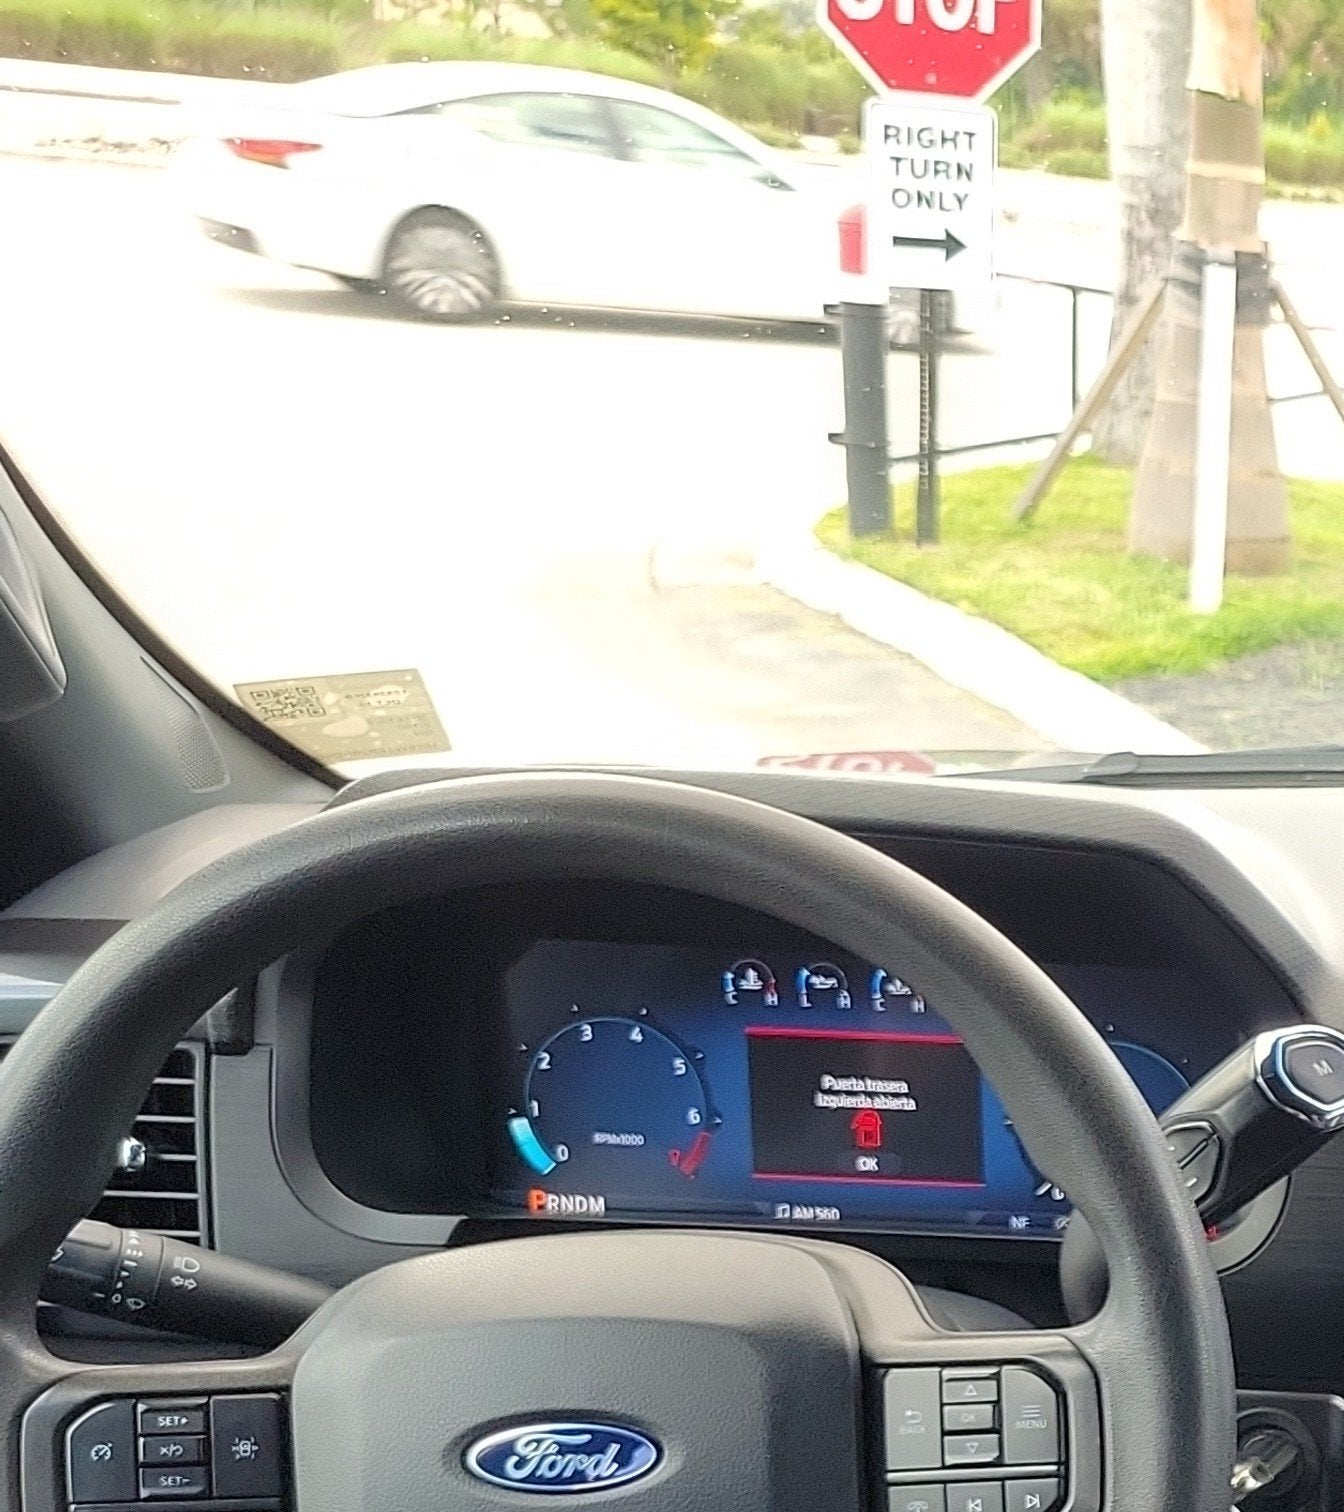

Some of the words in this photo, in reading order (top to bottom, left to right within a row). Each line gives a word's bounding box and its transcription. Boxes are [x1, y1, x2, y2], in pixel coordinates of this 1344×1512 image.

[884, 124, 976, 151] RIGHT
[890, 156, 973, 182] TURN
[891, 188, 969, 212] ONLY
[580, 1024, 593, 1041] 3
[630, 1026, 643, 1043] 4
[537, 1052, 551, 1070] 2
[673, 1057, 686, 1076] 5
[820, 1074, 865, 1091] Puerta
[865, 1076, 909, 1093] trasera
[530, 1100, 539, 1117] 1
[872, 1094, 917, 1111] abierta
[687, 1107, 701, 1125] 6
[556, 1144, 569, 1161] 0
[855, 1156, 879, 1172] OK
[792, 1205, 814, 1220] AM
[1016, 1420, 1048, 1430] MENU
[506, 1433, 621, 1481] Ford
